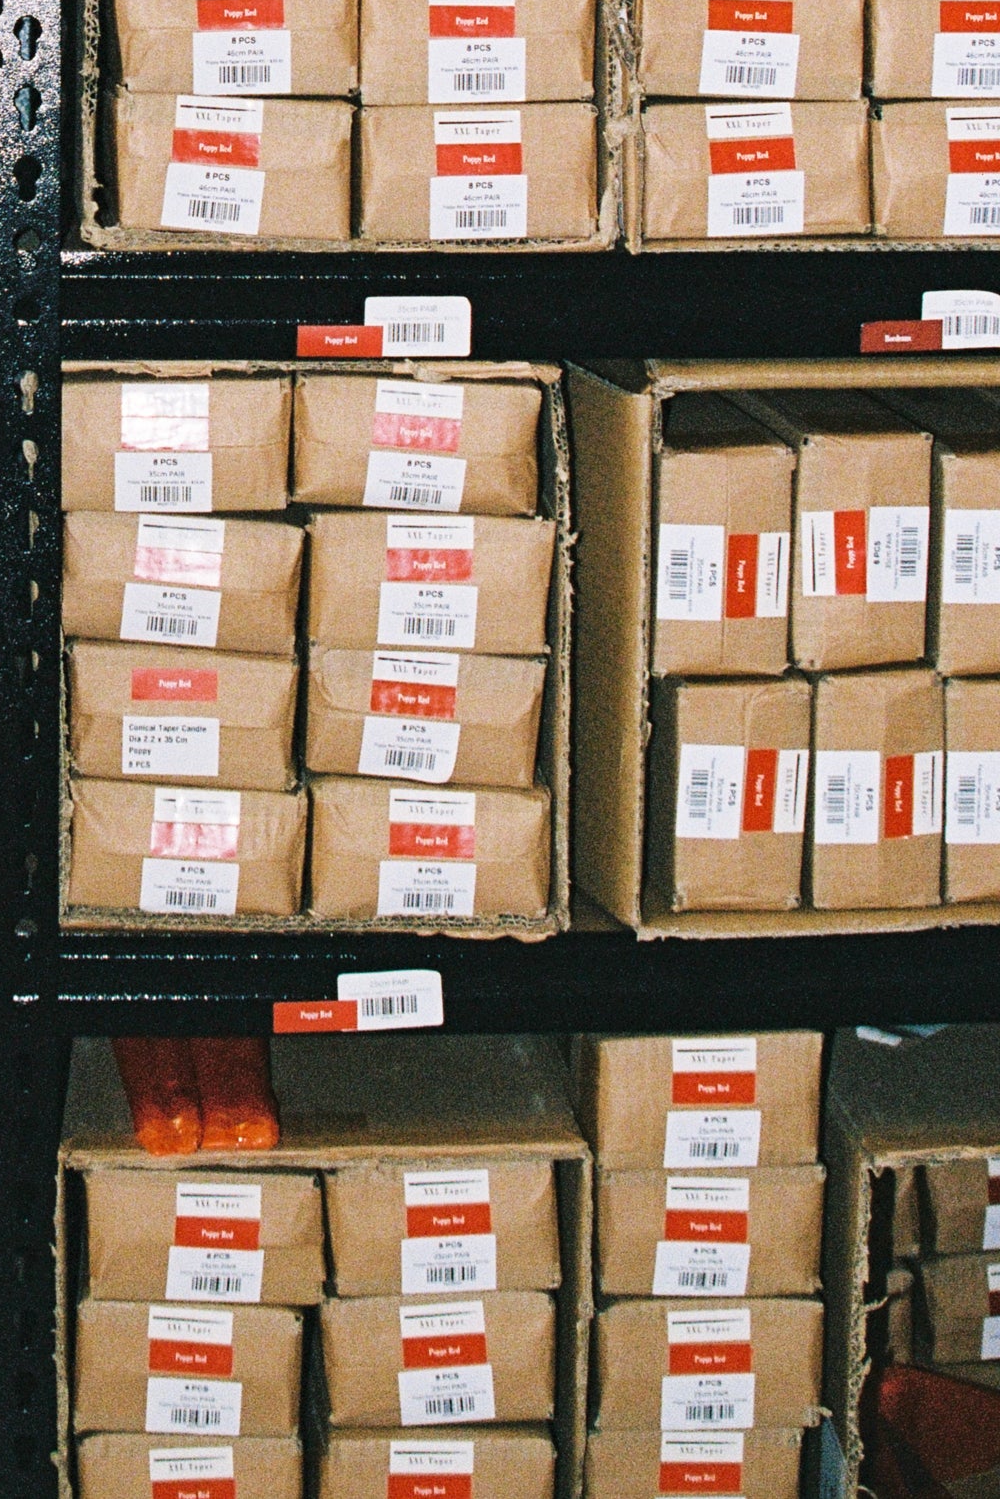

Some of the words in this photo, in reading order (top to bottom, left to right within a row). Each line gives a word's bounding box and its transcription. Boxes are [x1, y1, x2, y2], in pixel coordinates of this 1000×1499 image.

[474, 126, 500, 136] Taper
[462, 155, 482, 165] Poppy
[483, 154, 496, 163] Red
[475, 181, 493, 189] PCS
[324, 336, 344, 346] Poppy
[344, 336, 358, 344] Red
[158, 679, 178, 689] Poppy
[178, 679, 192, 688] Red
[128, 746, 152, 756] Poppy
[415, 836, 435, 846] Poppy
[435, 836, 448, 845] Red
[300, 1010, 319, 1020] Poppy
[319, 1010, 333, 1019] Red
[697, 1083, 716, 1094] Poppy
[717, 1083, 730, 1092] Red
